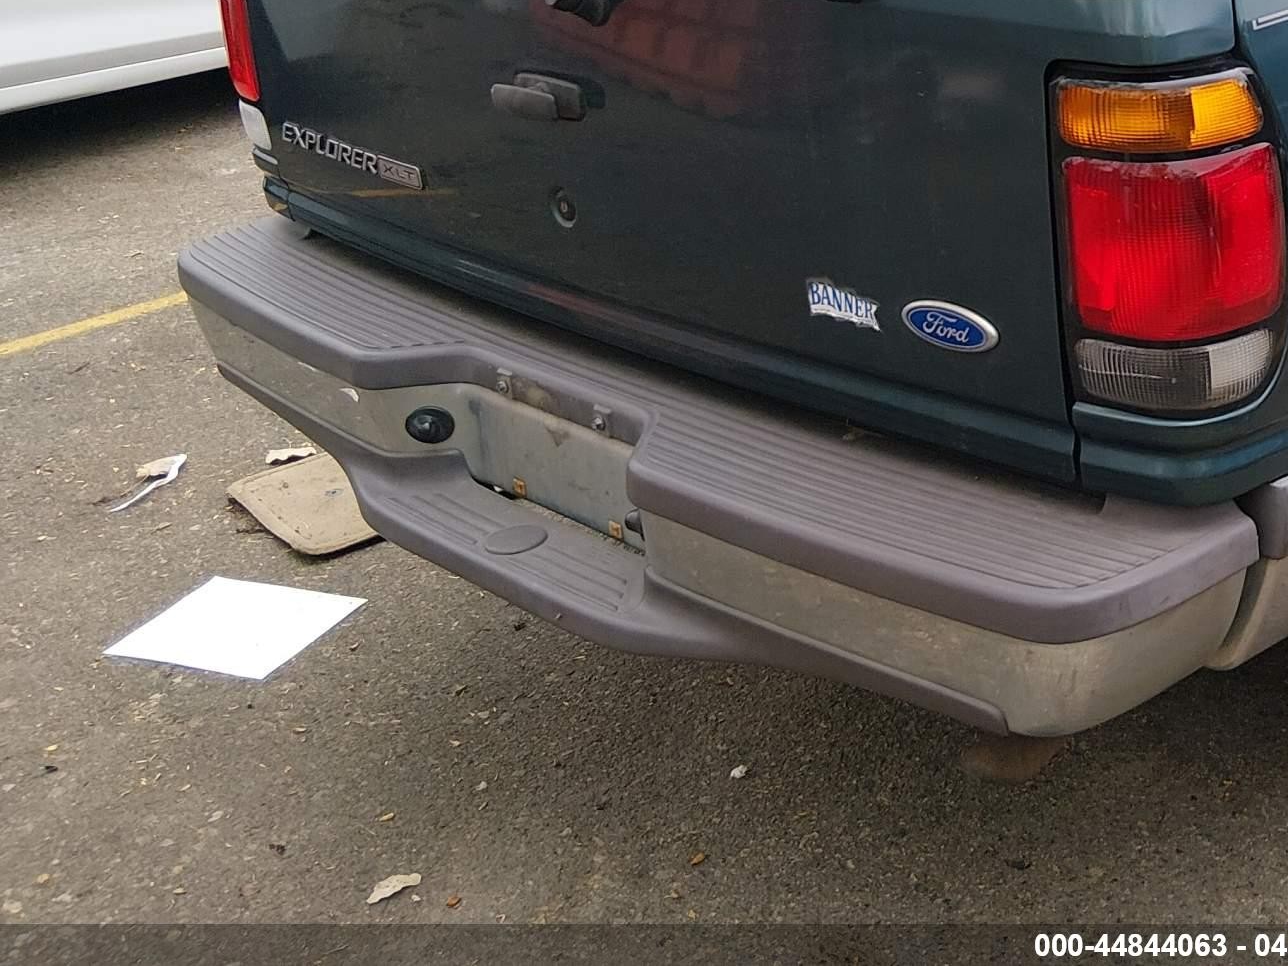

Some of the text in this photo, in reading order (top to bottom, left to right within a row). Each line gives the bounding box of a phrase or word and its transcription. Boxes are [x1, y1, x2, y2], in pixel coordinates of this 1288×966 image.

[282, 121, 378, 174] EXPLORER
[810, 281, 876, 320] BANNER
[922, 311, 971, 343] Ford
